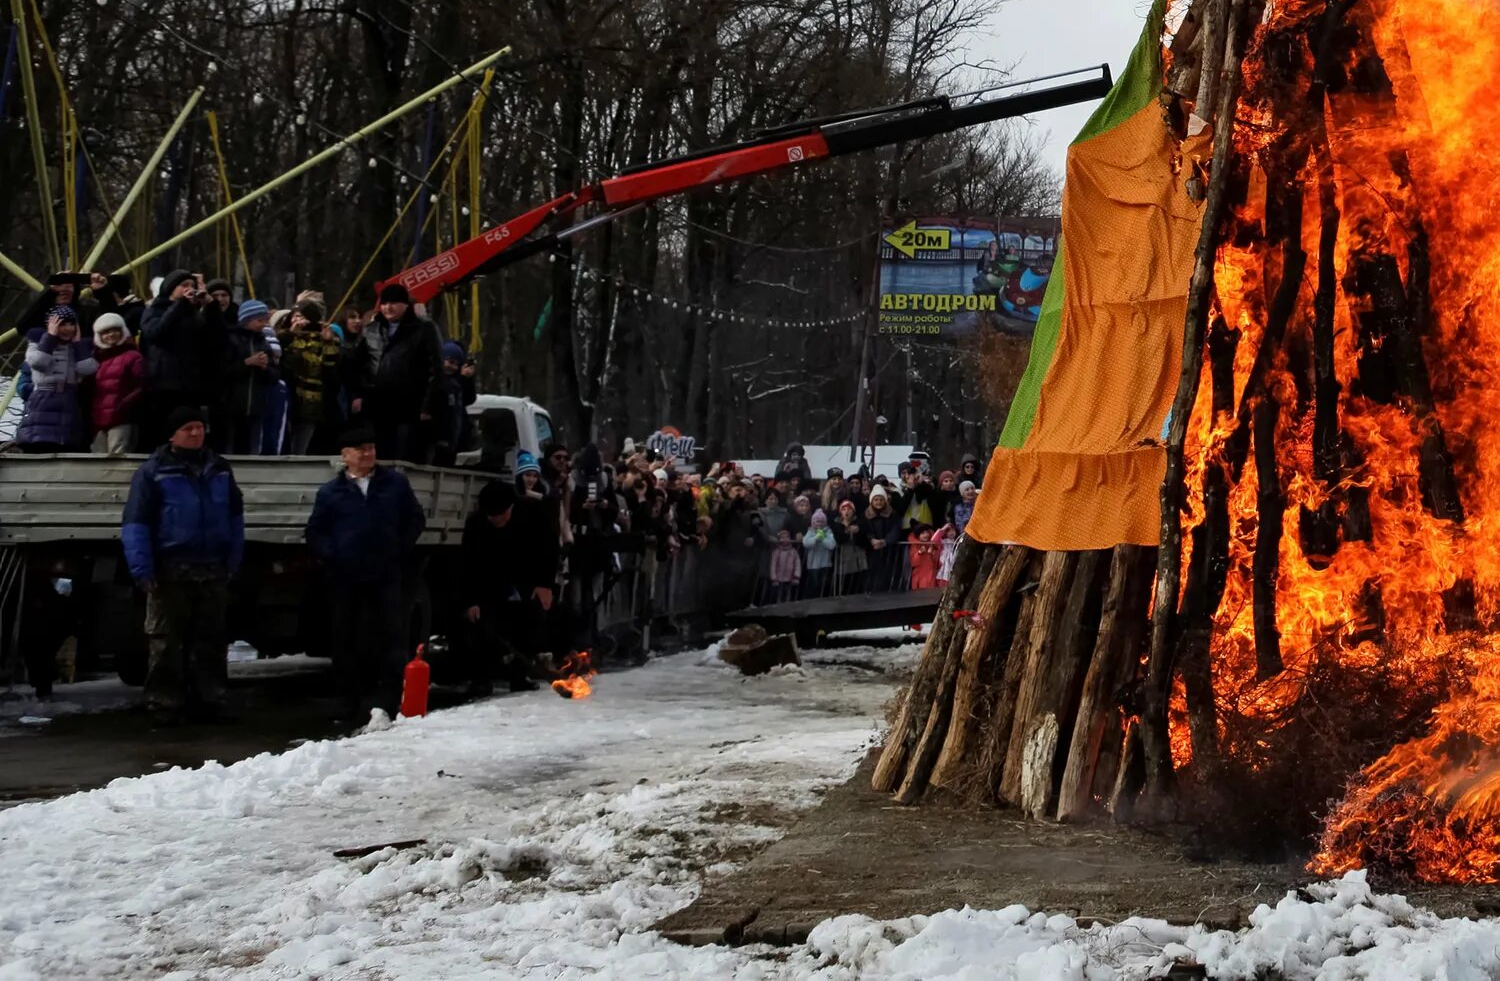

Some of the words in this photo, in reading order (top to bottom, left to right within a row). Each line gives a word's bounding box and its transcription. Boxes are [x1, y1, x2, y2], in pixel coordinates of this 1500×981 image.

[484, 226, 510, 245] F65
[901, 231, 942, 247] 20м
[403, 255, 457, 288] FASSI
[880, 293, 997, 312] АВТОДРОМ
[879, 314, 913, 323] Режим
[879, 326, 885, 334] с
[887, 325, 940, 334] 11.00-21.00
